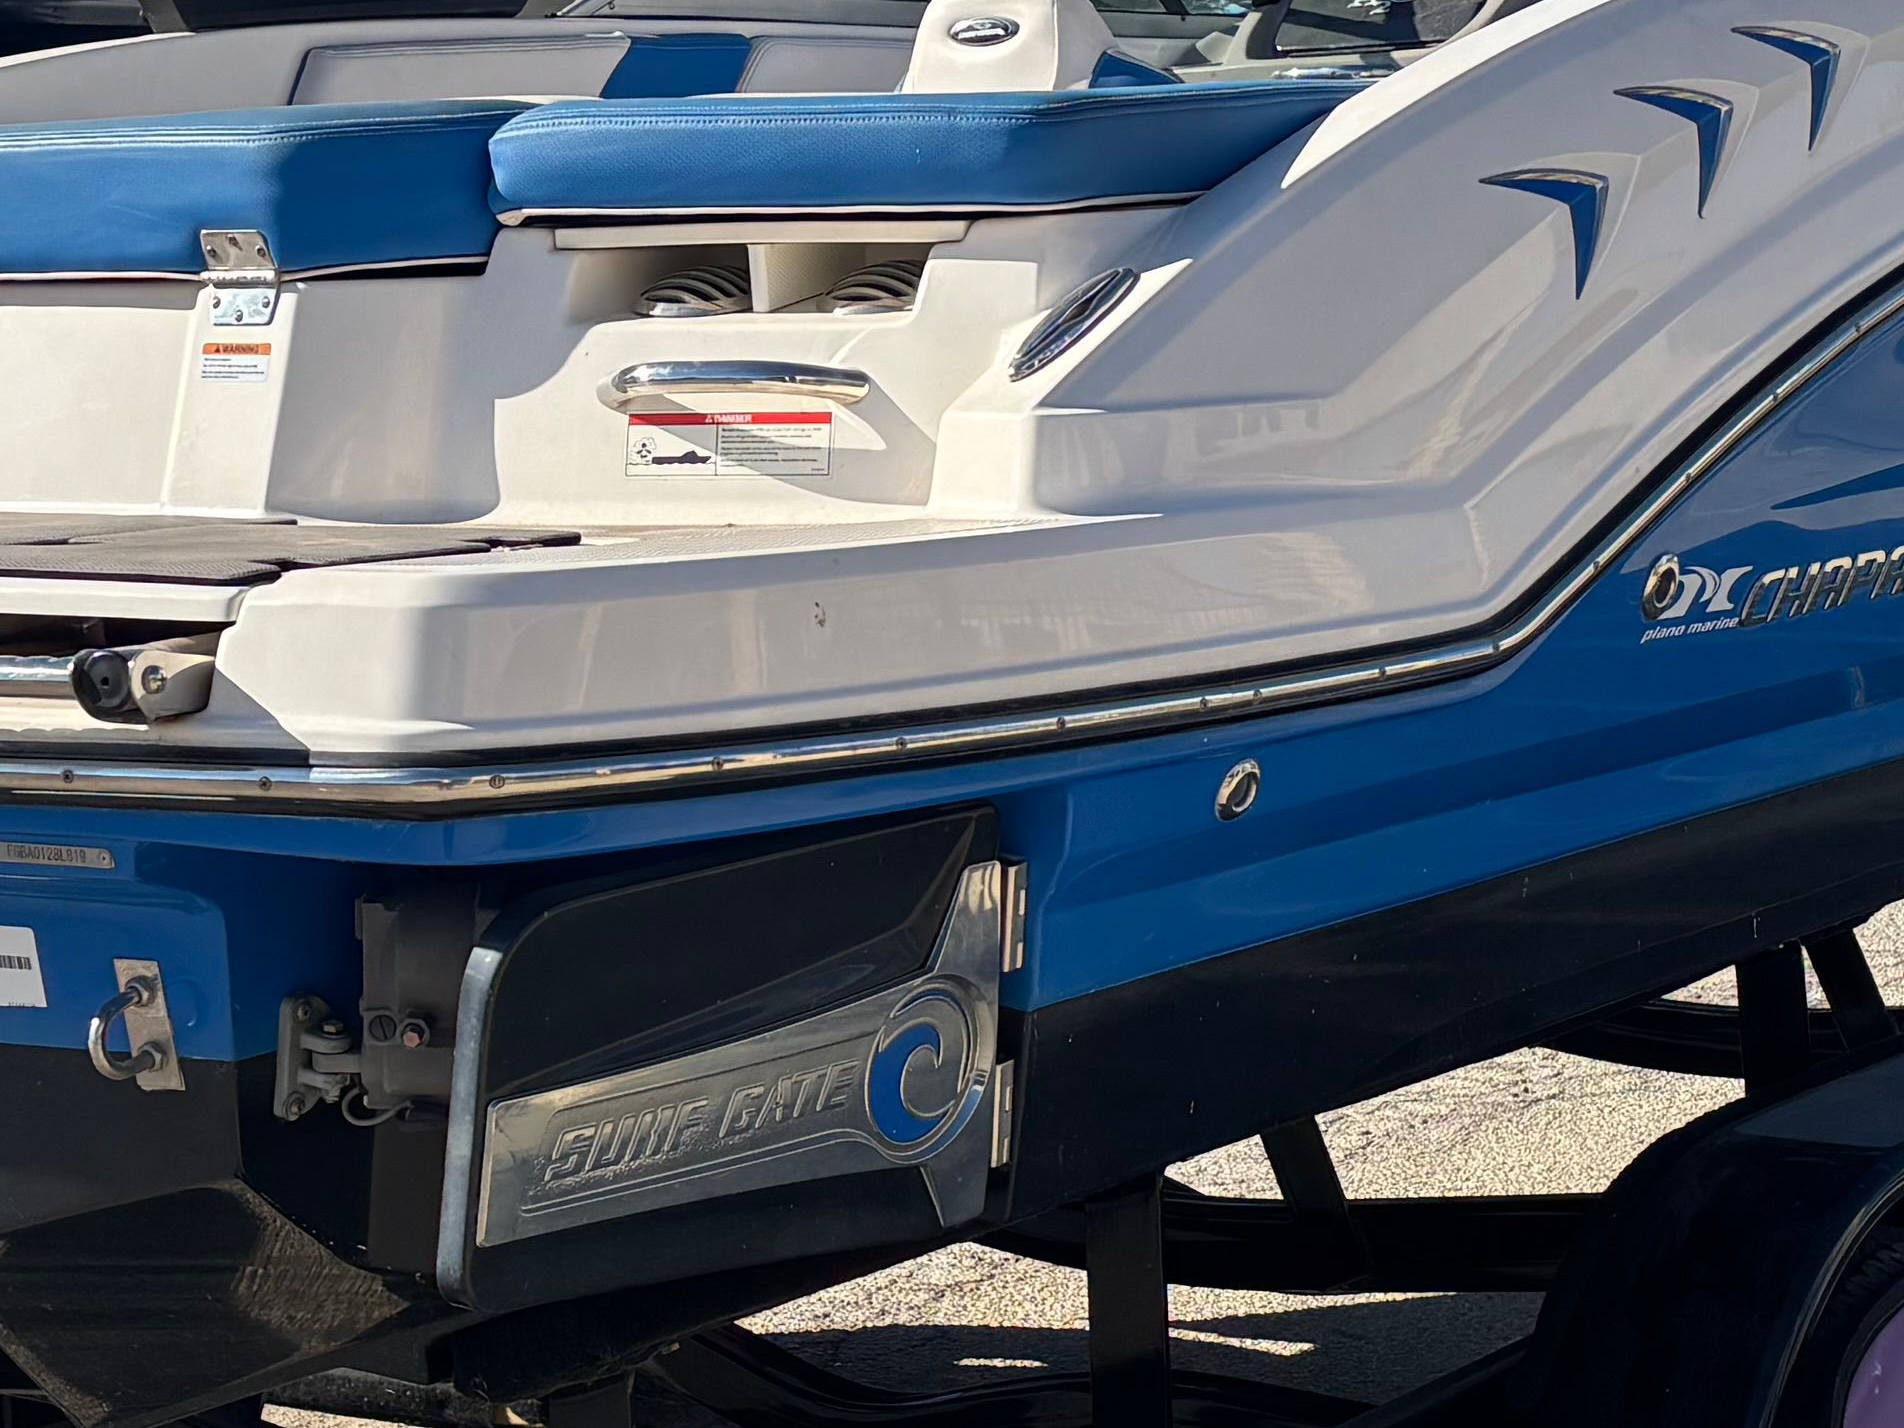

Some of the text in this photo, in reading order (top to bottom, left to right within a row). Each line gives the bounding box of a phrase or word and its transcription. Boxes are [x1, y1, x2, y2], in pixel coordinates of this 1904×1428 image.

[713, 413, 753, 423] DANGER
[1639, 616, 1741, 644] plano marine
[718, 1059, 859, 1139] GATE
